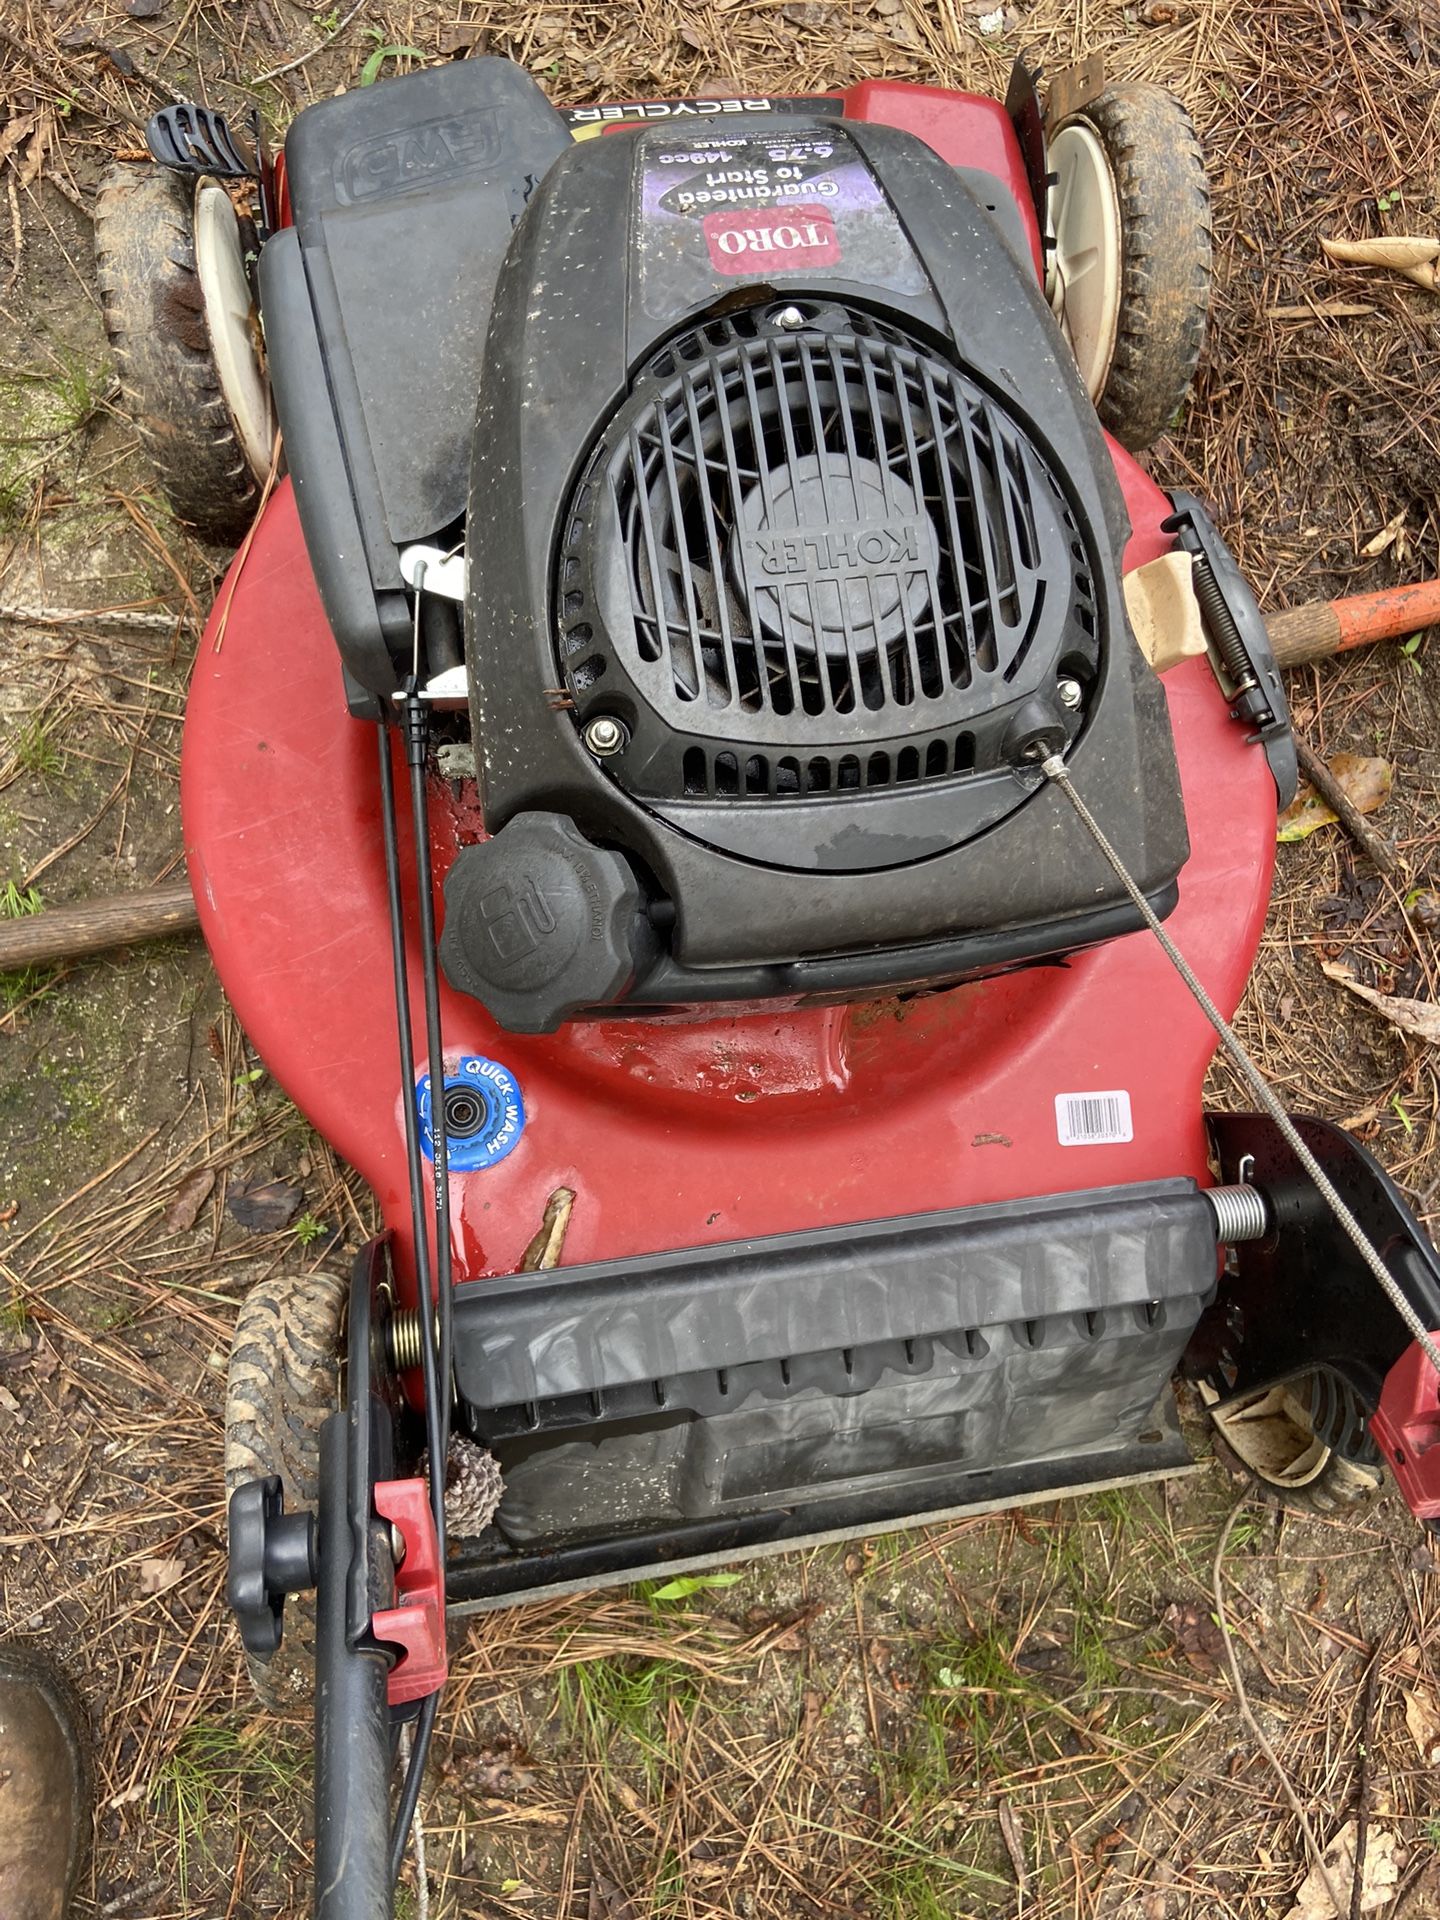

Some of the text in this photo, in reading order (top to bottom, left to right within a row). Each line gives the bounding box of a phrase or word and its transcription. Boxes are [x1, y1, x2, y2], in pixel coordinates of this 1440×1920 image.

[573, 98, 771, 121] RECYCLER
[358, 122, 485, 183] FWD
[692, 138, 747, 149] KOHLER
[768, 145, 834, 161] 6.75
[658, 150, 733, 165] 149cc
[704, 166, 802, 188] to Start
[677, 180, 840, 206] Guaranteed
[717, 222, 829, 255] TORO
[755, 526, 919, 575] KOHLER
[465, 1059, 519, 1155] QUICK-WASH
[433, 1127, 441, 1147] 112
